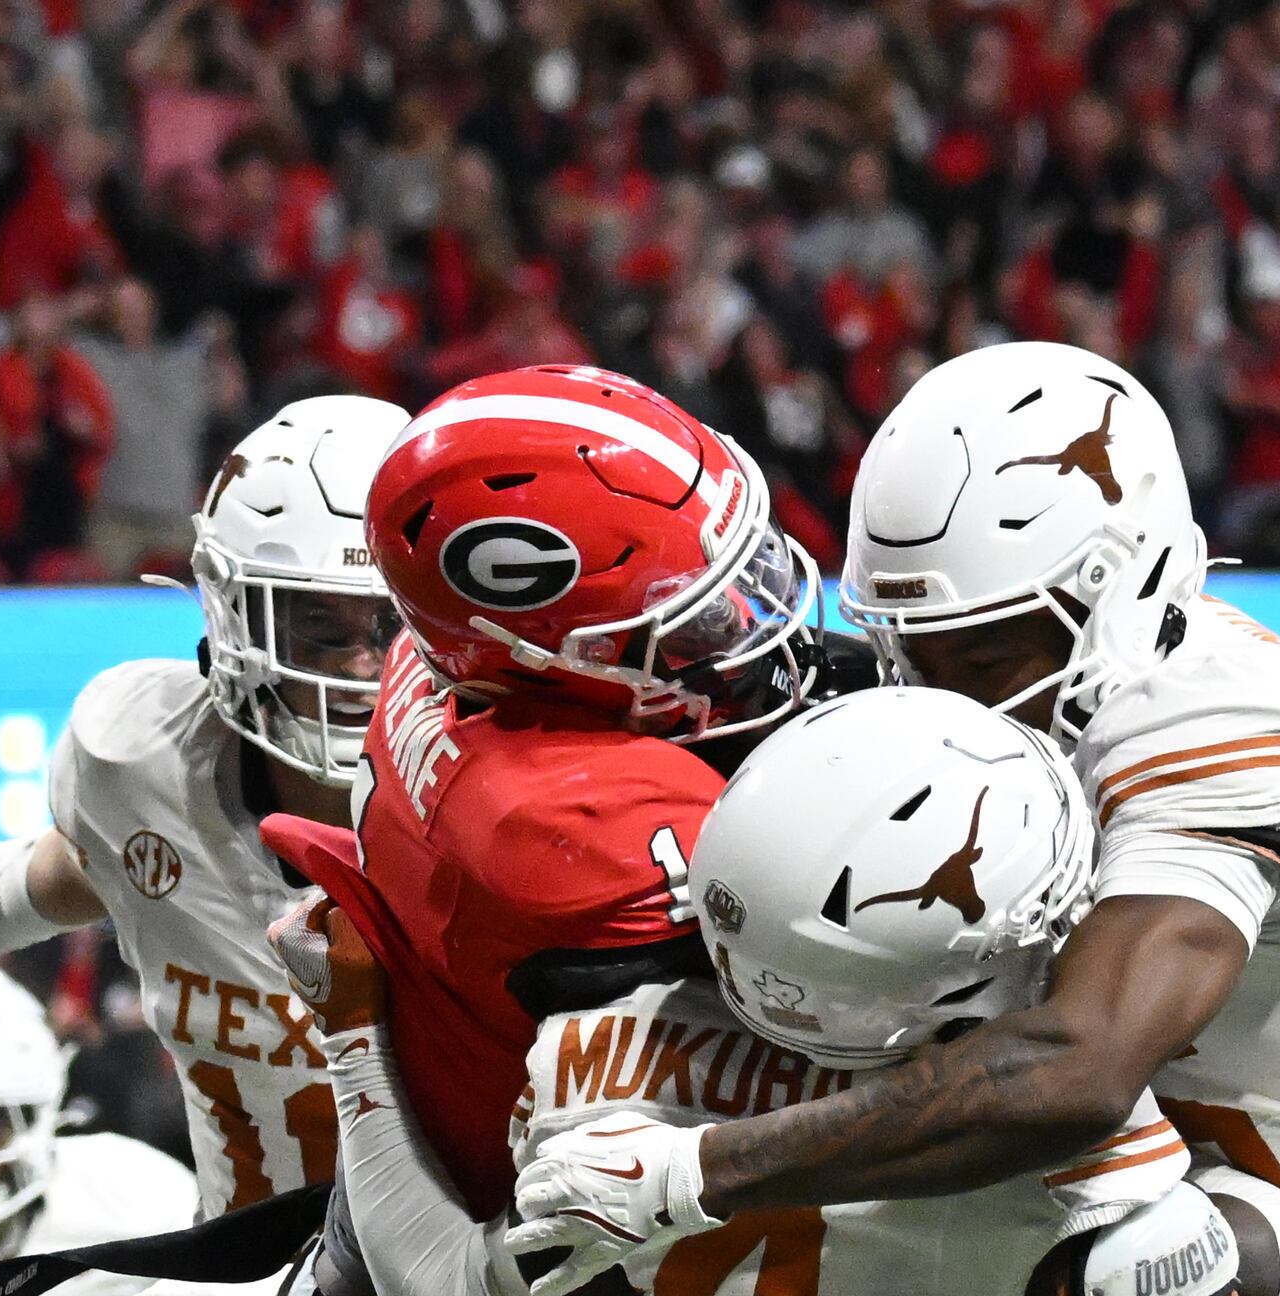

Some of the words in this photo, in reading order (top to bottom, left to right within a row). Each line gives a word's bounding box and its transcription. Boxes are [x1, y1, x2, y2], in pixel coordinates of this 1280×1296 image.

[440, 517, 581, 611] G
[123, 829, 183, 900] SEC
[647, 825, 698, 923] 1
